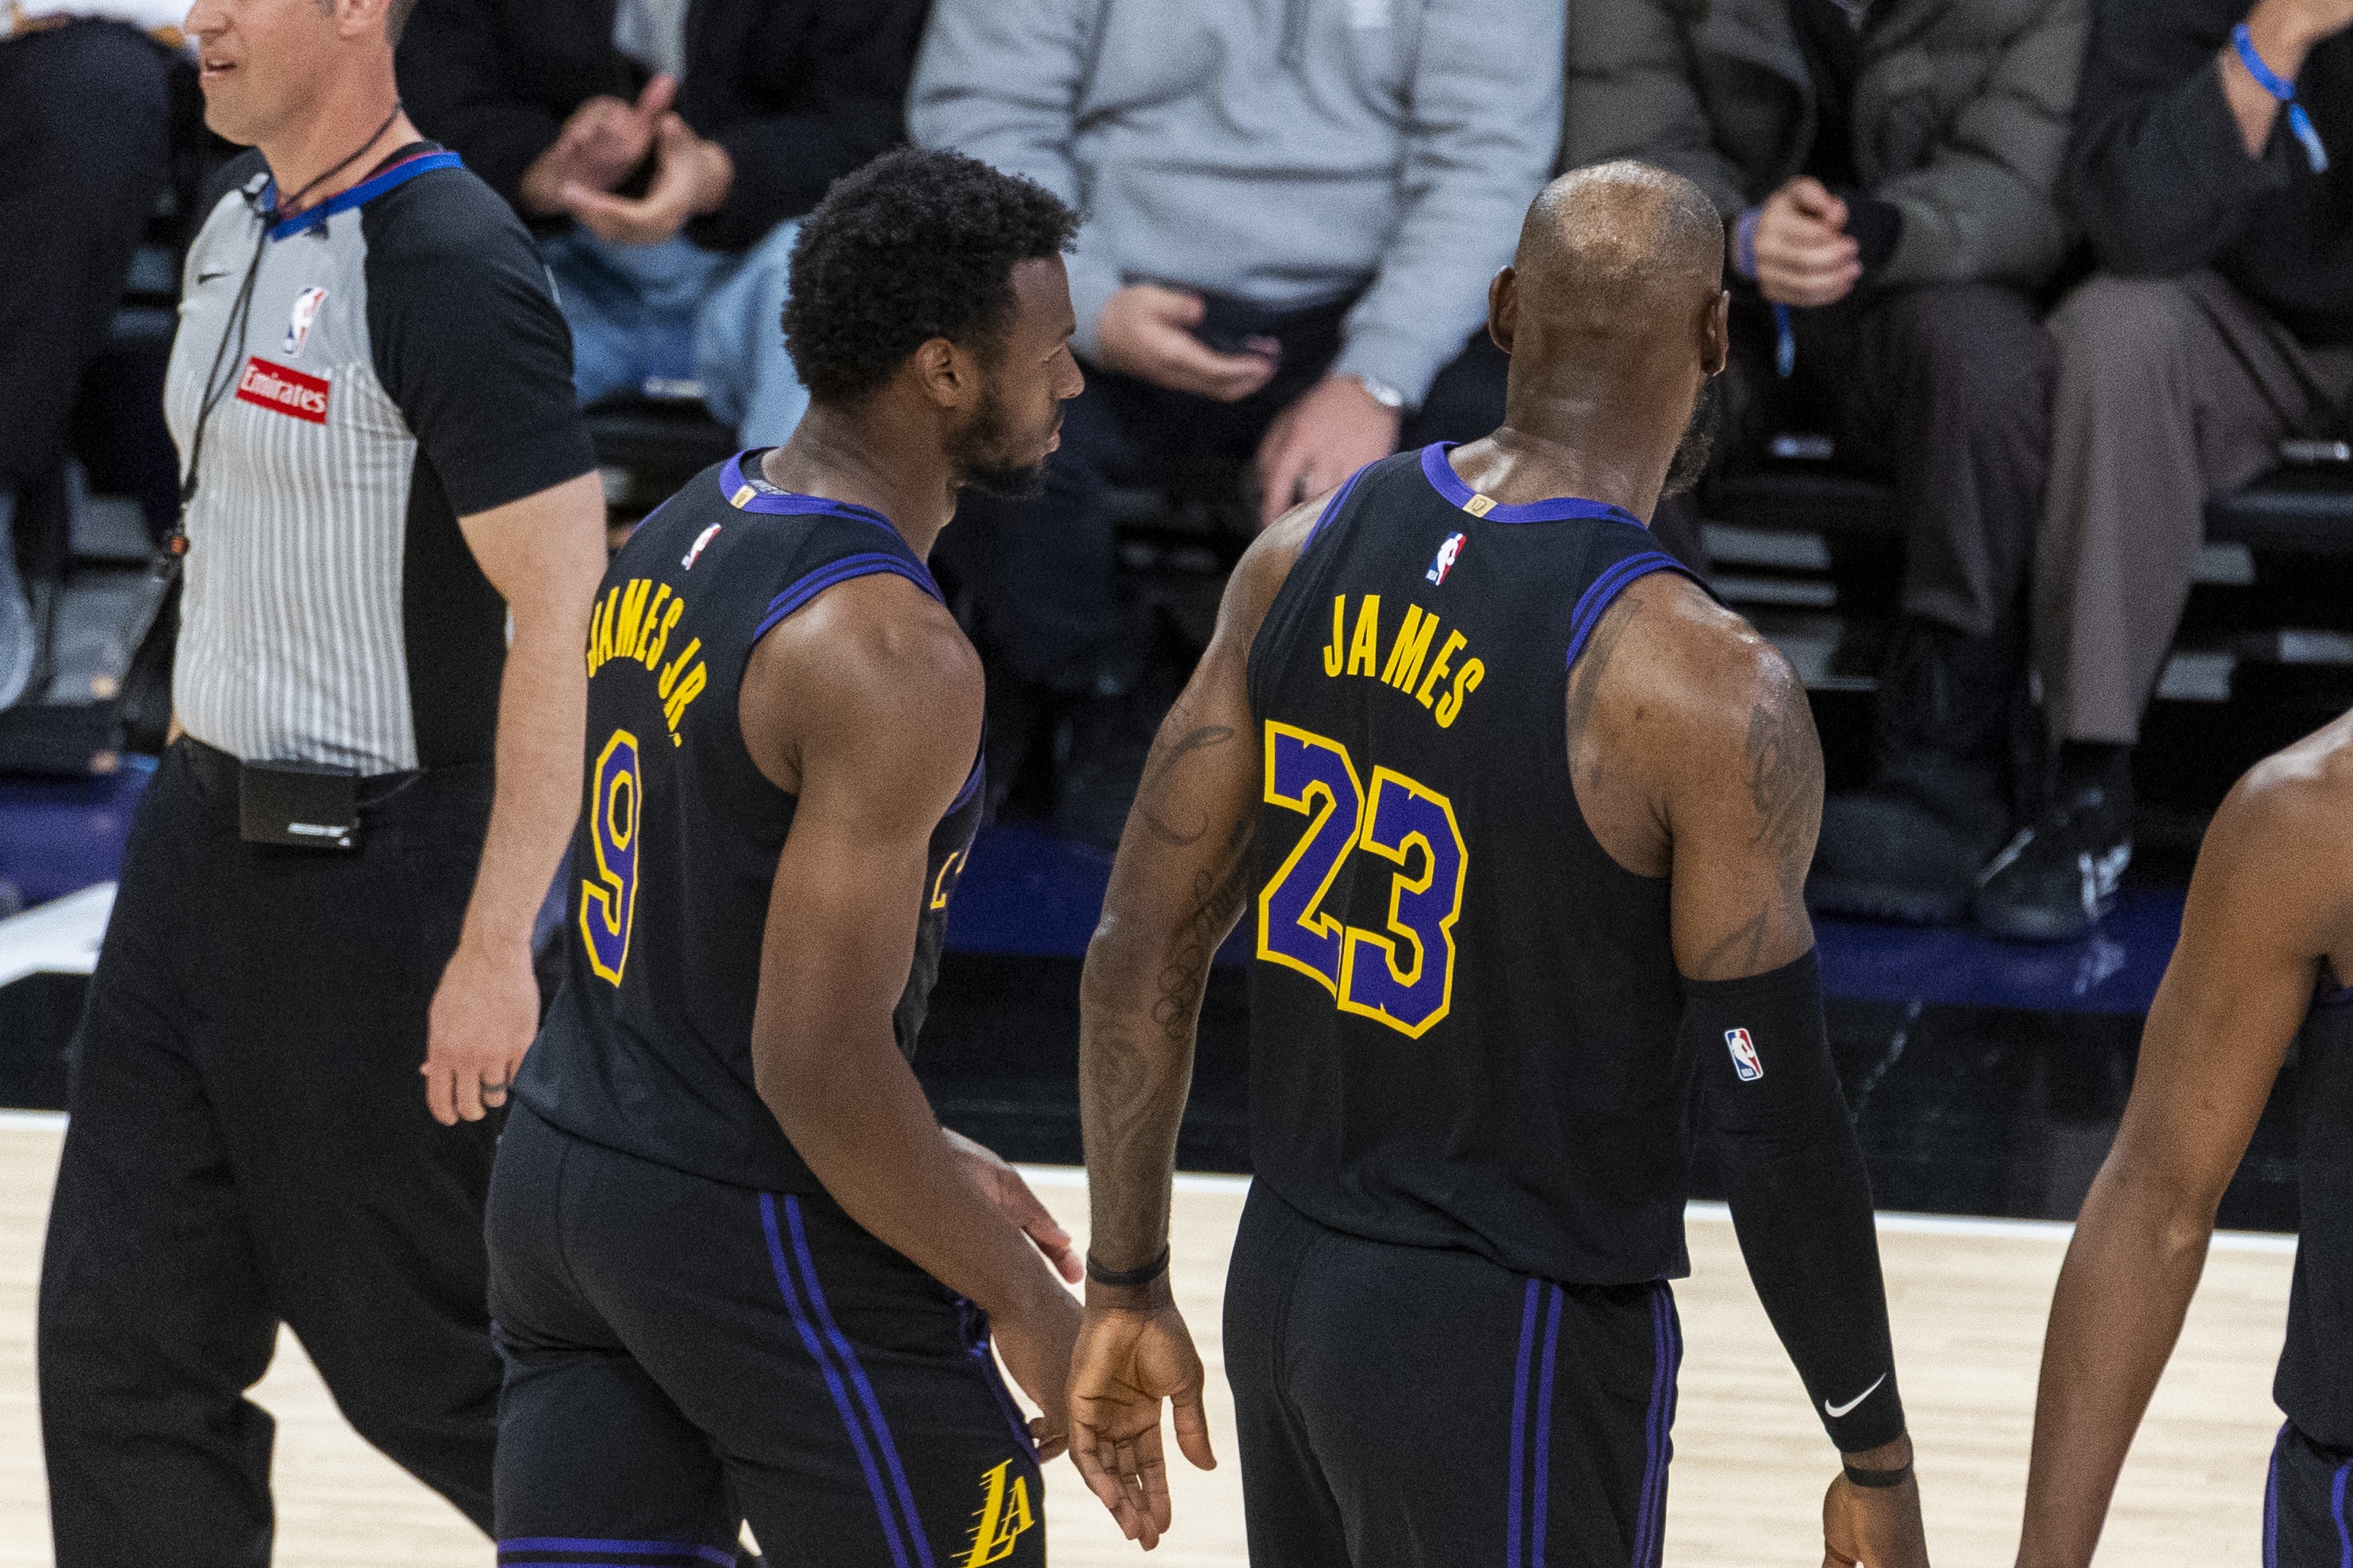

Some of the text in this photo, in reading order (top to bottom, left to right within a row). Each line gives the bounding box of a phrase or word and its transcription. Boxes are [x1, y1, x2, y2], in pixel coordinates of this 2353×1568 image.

[240, 364, 327, 413] Emirates
[586, 578, 708, 748] JAMES JR.
[1323, 594, 1485, 728] JAMES
[580, 728, 642, 987] 9
[1257, 719, 1468, 1040] 23
[950, 1458, 1035, 1568] LA
